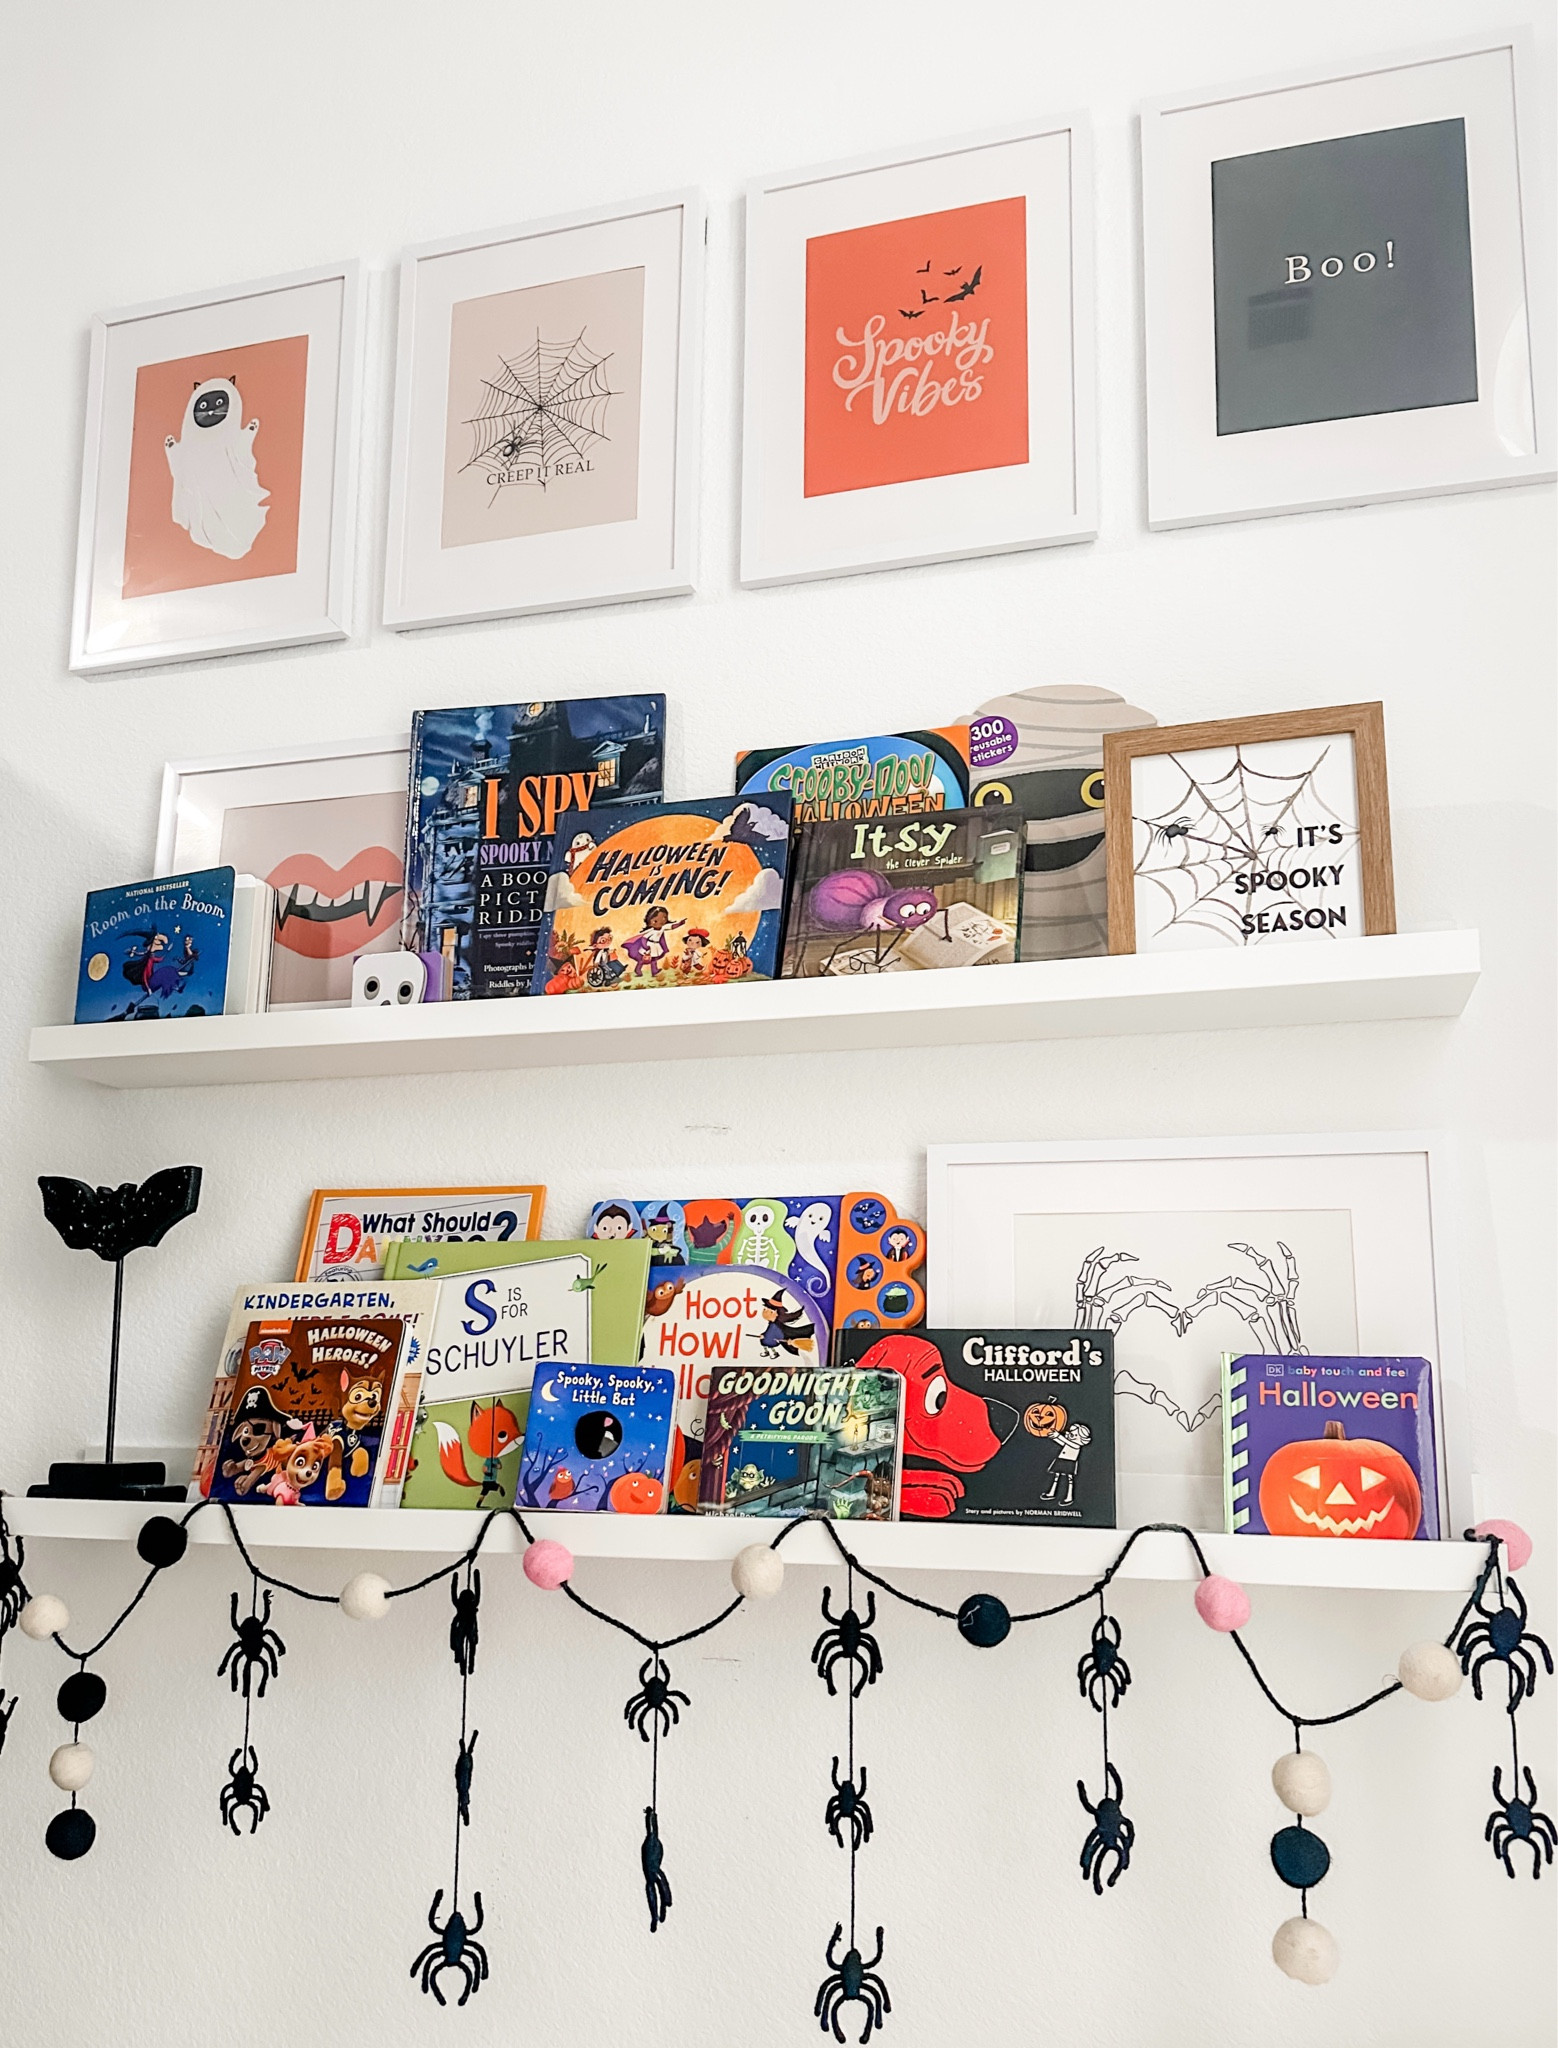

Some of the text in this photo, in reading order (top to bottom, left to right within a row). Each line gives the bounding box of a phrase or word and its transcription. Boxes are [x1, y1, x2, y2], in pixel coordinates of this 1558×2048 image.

[1284, 240, 1394, 284] Boo!
[832, 311, 994, 389] Spooky
[845, 360, 985, 425] Vibes
[487, 460, 595, 486] CREEP IT REAL
[971, 720, 1004, 740] 300
[814, 747, 865, 764] CARTOON
[970, 734, 1012, 753] reusable
[972, 745, 1013, 762] stickers
[768, 752, 936, 804] SCOOBY-DOO!
[482, 771, 599, 840] I SPY
[850, 822, 956, 860] Itsy
[1297, 824, 1343, 848] IT'S
[480, 841, 542, 865] SPOOKY
[585, 842, 728, 884] HALLOWEEN
[886, 853, 964, 870] the Clever Spider
[480, 871, 547, 888] A BOO
[649, 864, 663, 877] IS
[1234, 864, 1344, 894] SPOOKY
[126, 881, 190, 898] NATIONAL BESTSELLER
[480, 890, 539, 907] PICT
[592, 866, 733, 916] COMING!
[90, 893, 225, 938] Room on the Broom
[479, 908, 542, 924] RIDD
[1241, 906, 1347, 935] SEASON
[484, 963, 527, 972] Photographs
[516, 980, 525, 988] by
[362, 1213, 416, 1233] What
[422, 1211, 492, 1232] Should
[244, 1292, 395, 1310] KINDERGARTEN,
[461, 1279, 497, 1336] S
[508, 1287, 522, 1302] IS
[501, 1303, 528, 1319] FOR
[686, 1287, 758, 1320] Hoot
[307, 1326, 392, 1353] HALLOWEEN
[660, 1322, 742, 1359] Howl
[962, 1337, 1103, 1366] Clifford's
[249, 1346, 291, 1364] PAW
[312, 1346, 378, 1369] HEROES!
[426, 1329, 568, 1375] SCHUYLER
[557, 1371, 655, 1393] Spooky, Spooky,
[718, 1371, 867, 1396] GOODNIGHT
[984, 1369, 1081, 1382] HALLOWEEN
[1288, 1366, 1317, 1377] baby
[1321, 1366, 1354, 1376] touch
[1359, 1367, 1382, 1376] and
[1386, 1368, 1409, 1377] feel
[572, 1390, 635, 1406] Little Bat
[1259, 1381, 1418, 1410] Halloween
[769, 1401, 842, 1426] GOON
